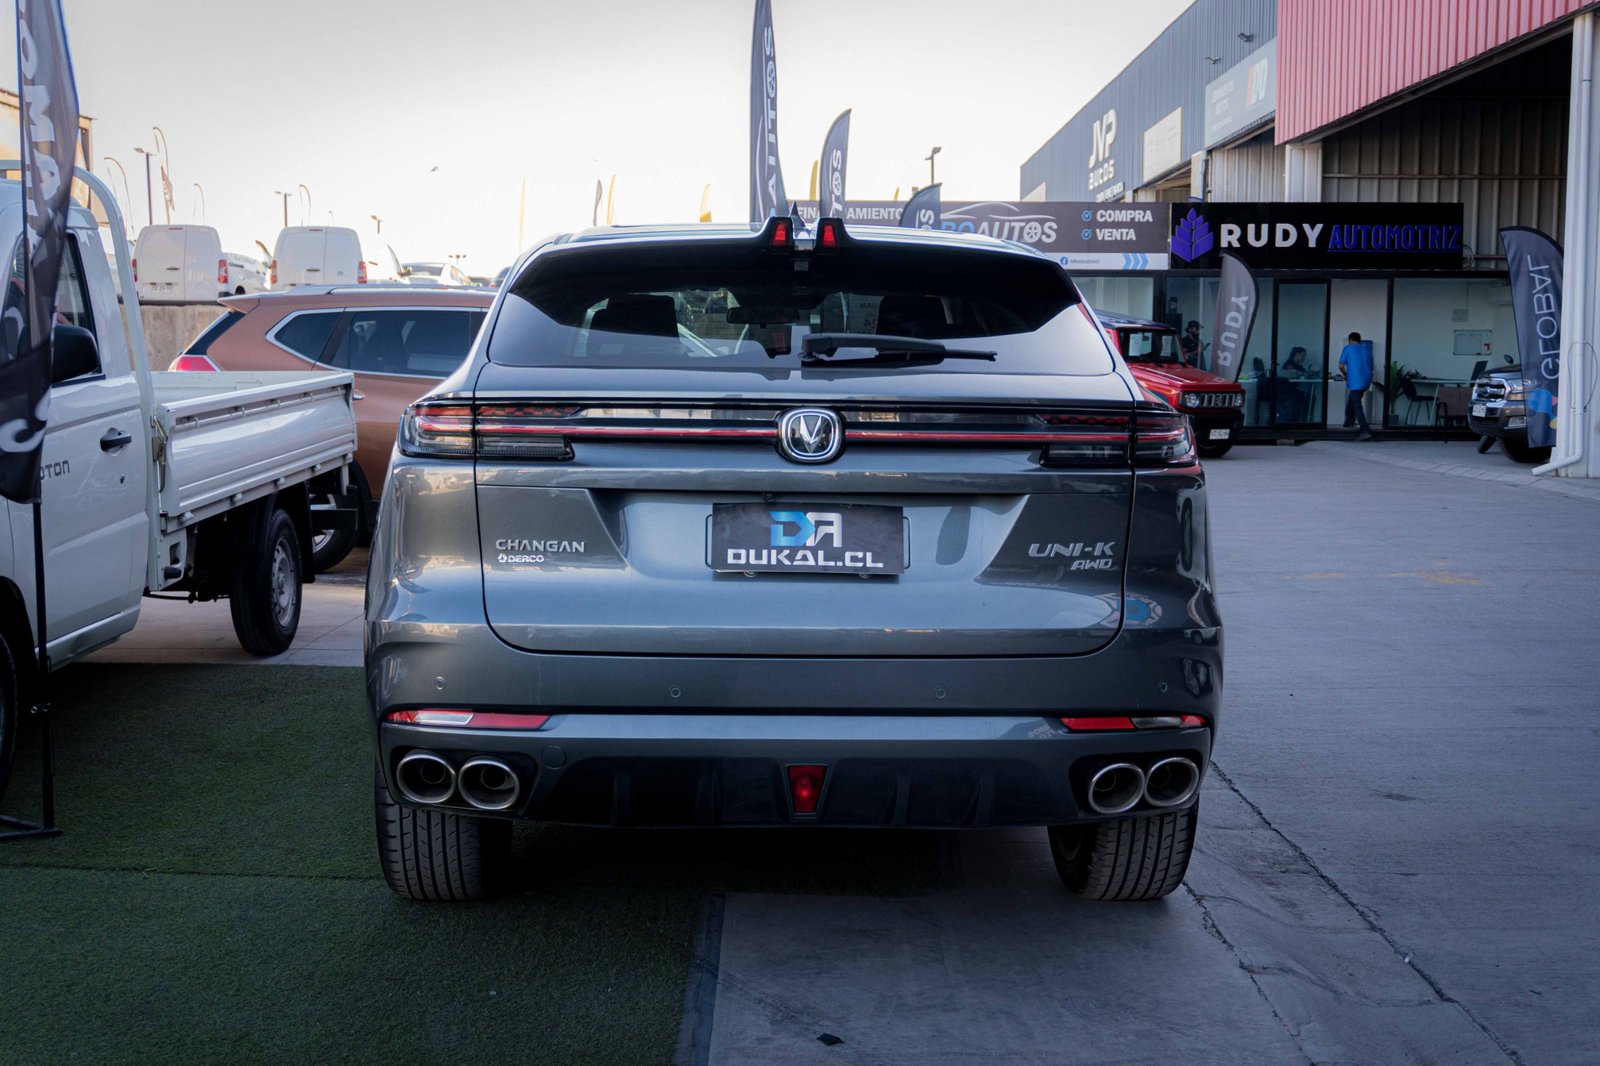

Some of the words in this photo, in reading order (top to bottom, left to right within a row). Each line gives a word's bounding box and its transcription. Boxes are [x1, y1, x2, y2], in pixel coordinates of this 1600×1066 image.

[764, 24, 777, 216] AUTOS
[1096, 210, 1153, 222] COMPRA
[1096, 228, 1136, 241] VENTA
[1220, 224, 1324, 248] RUDY
[1328, 225, 1462, 250] AUTOMOTRIZ
[1527, 254, 1560, 380] GLOBAL
[1217, 295, 1249, 367] RUDY
[40, 460, 70, 480] OTON
[495, 539, 585, 552] CHANGAN
[1028, 542, 1116, 557] UNI-K
[507, 554, 544, 562] DERCO
[727, 548, 884, 568] DUKAL.CL
[1070, 559, 1113, 570] AWD
